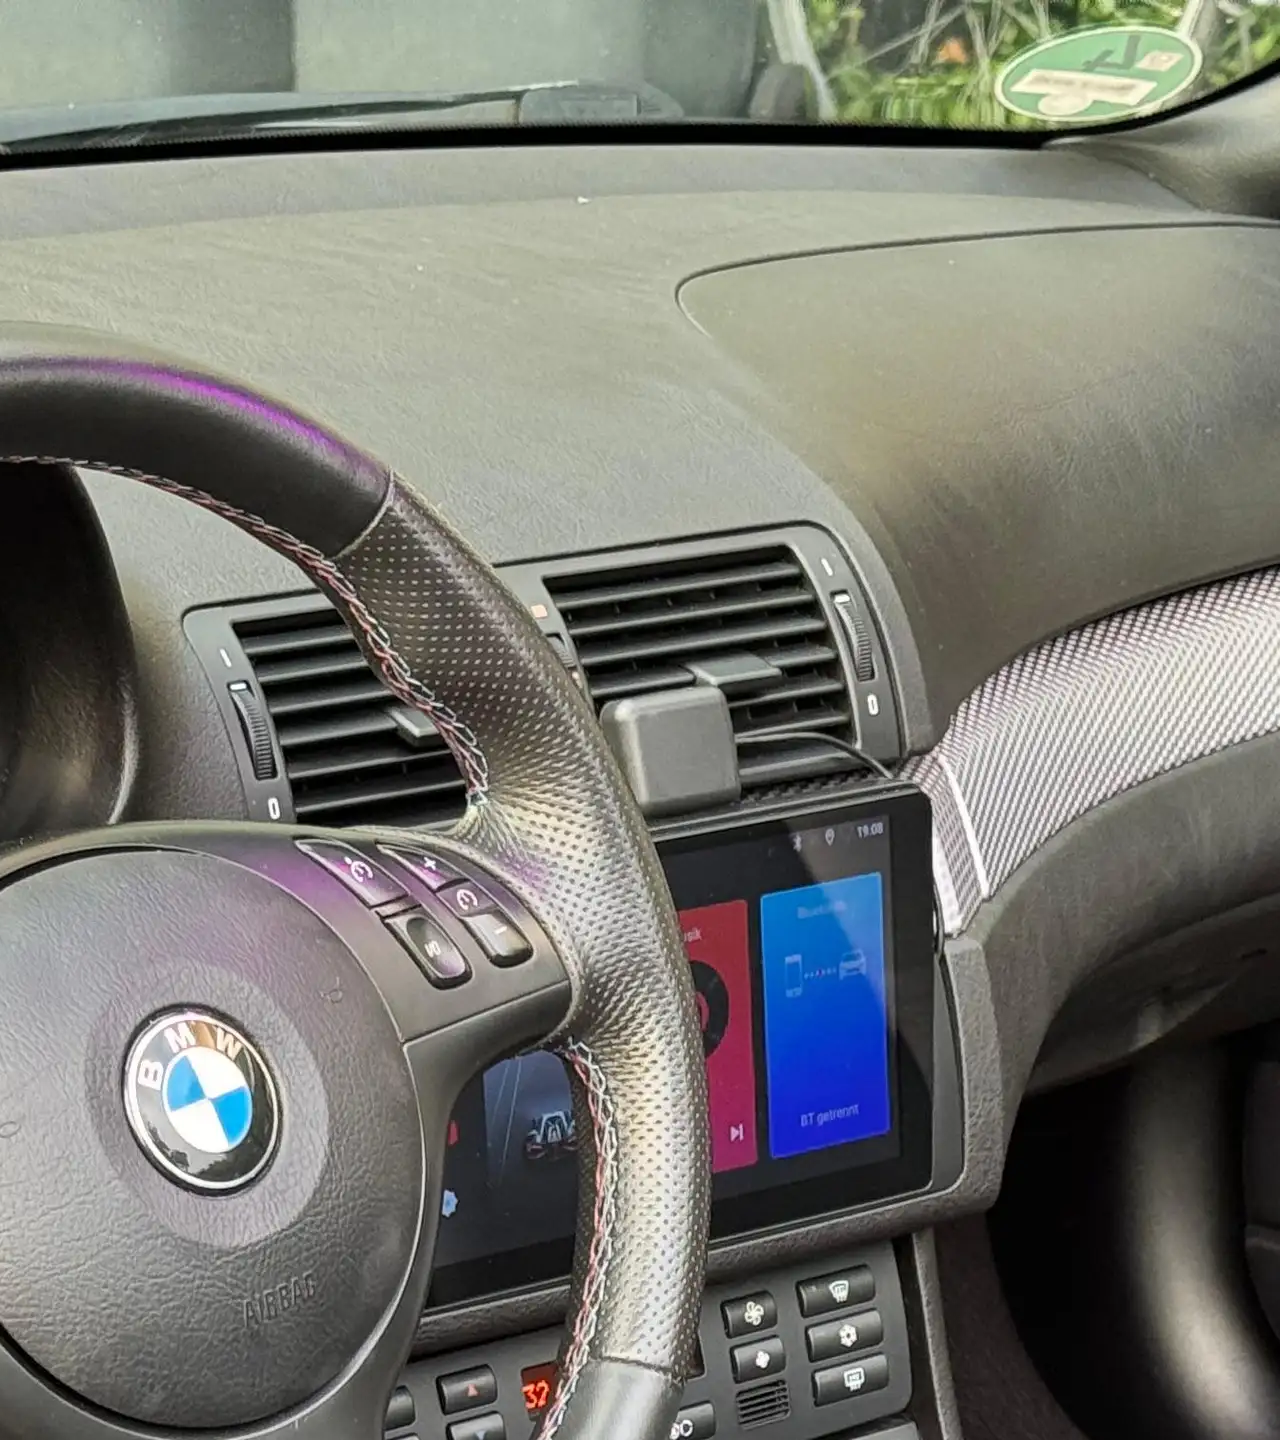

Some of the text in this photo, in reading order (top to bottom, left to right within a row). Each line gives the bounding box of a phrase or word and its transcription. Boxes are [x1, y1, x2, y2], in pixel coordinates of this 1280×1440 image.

[136, 1020, 245, 1091] BMW
[801, 1112, 814, 1127] BT
[243, 1271, 317, 1328] AIRBAG
